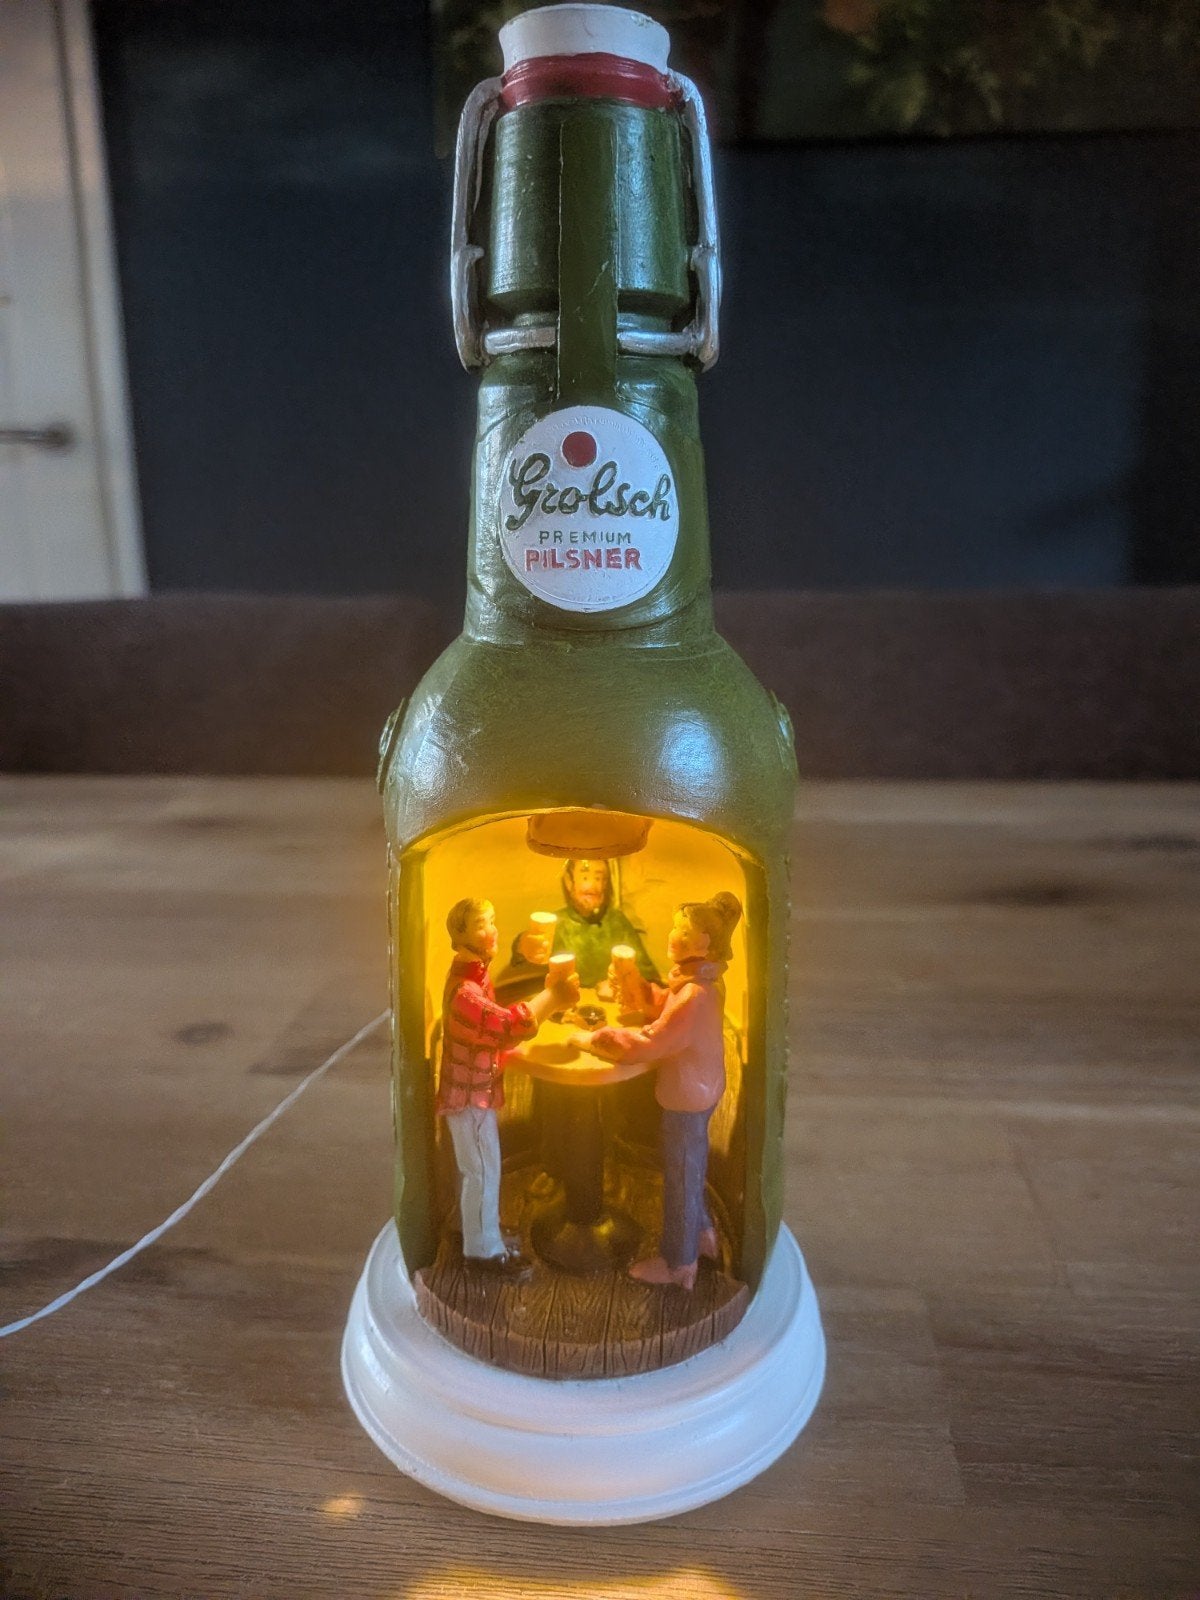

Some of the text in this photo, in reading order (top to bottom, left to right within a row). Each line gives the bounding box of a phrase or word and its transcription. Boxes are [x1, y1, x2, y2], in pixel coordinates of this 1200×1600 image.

[505, 452, 671, 530] Grolsch
[539, 530, 631, 545] PREMIUM
[525, 548, 642, 571] PILSNER
